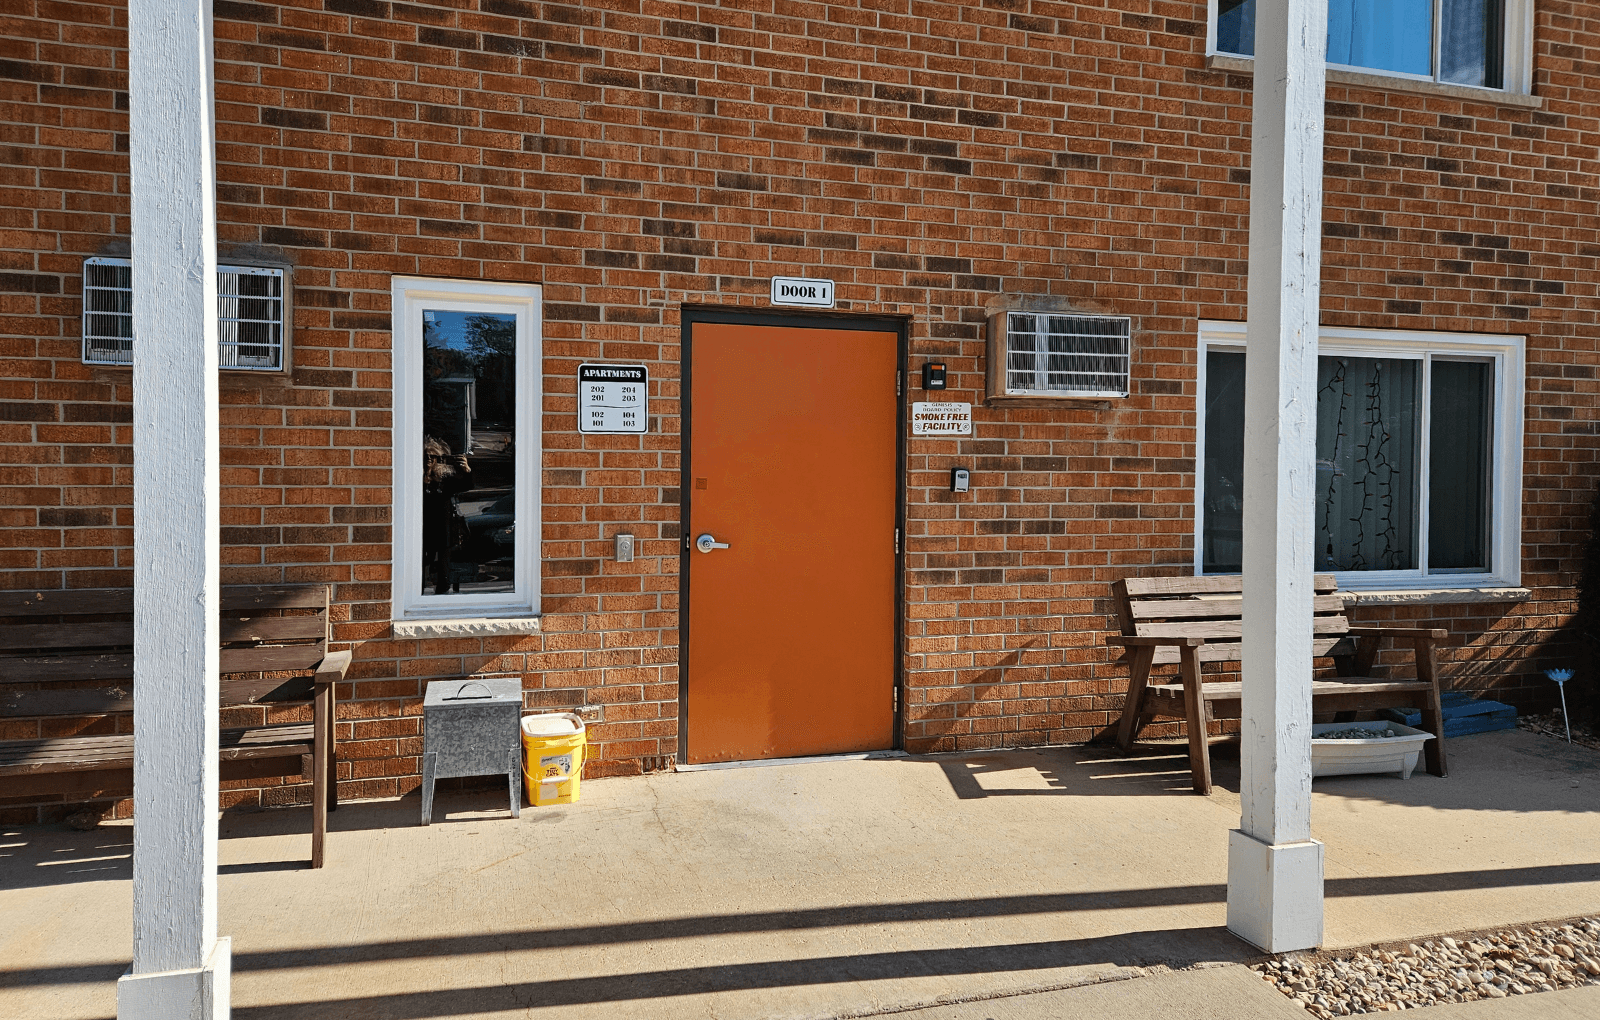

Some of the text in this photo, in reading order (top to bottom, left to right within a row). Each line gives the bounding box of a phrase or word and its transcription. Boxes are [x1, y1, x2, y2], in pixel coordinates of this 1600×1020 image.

[781, 285, 826, 298] DOOR 1
[583, 369, 641, 378] APARTMENTS
[914, 413, 969, 421] SMOKE FREE
[922, 422, 962, 430] FACILITY
